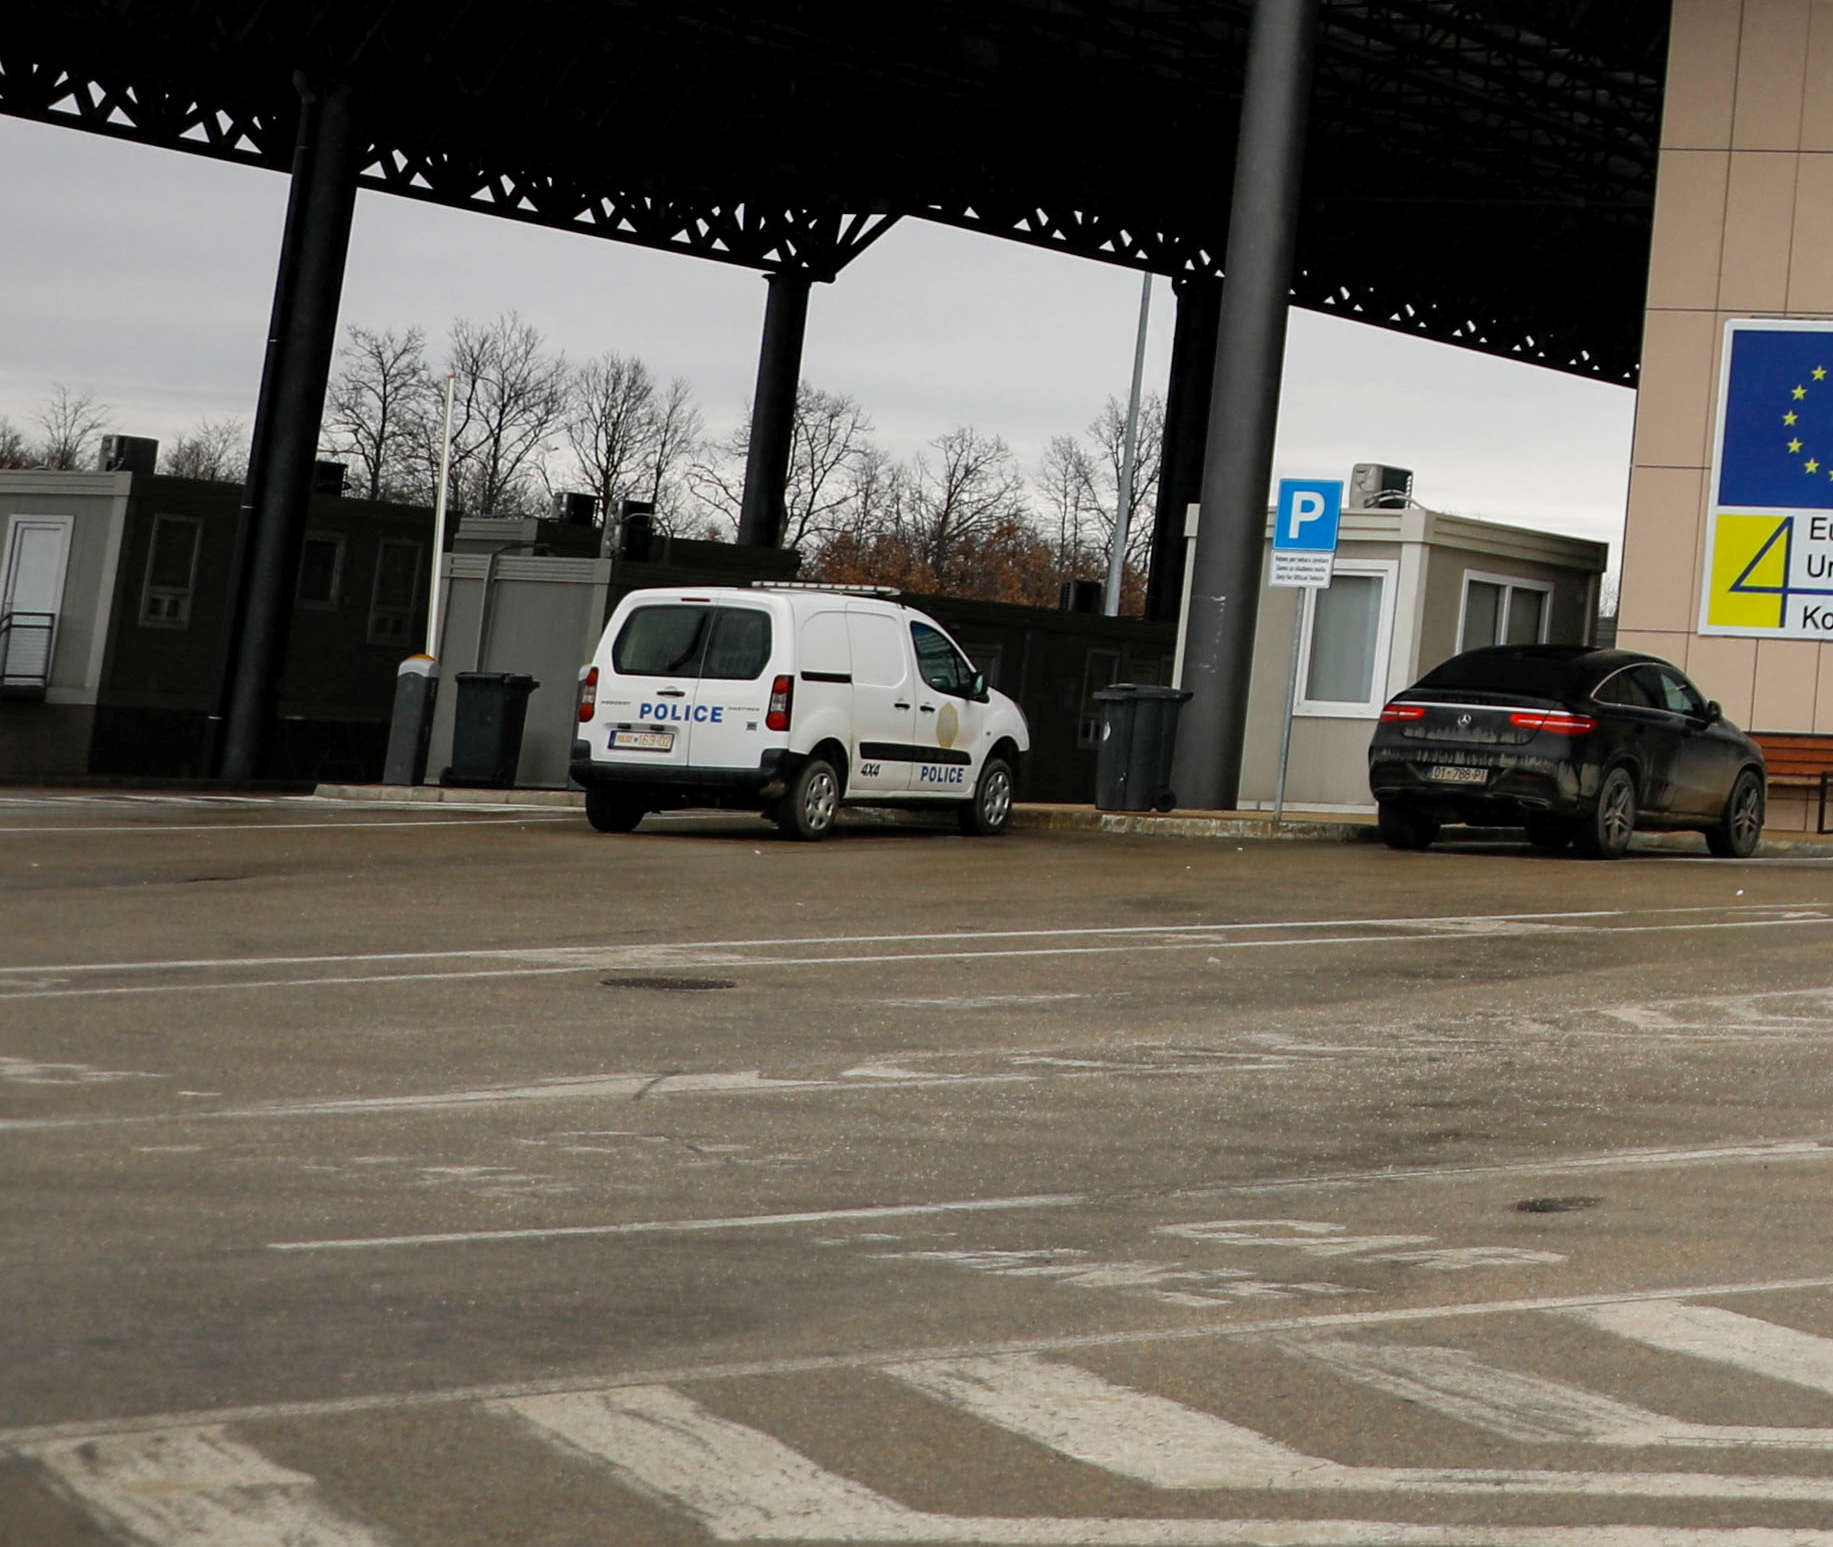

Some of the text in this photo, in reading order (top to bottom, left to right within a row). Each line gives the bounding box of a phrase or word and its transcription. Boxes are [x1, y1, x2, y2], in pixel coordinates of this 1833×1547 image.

[1288, 490, 1325, 539] P
[639, 702, 724, 723] POLICE
[920, 765, 965, 783] POLICE
